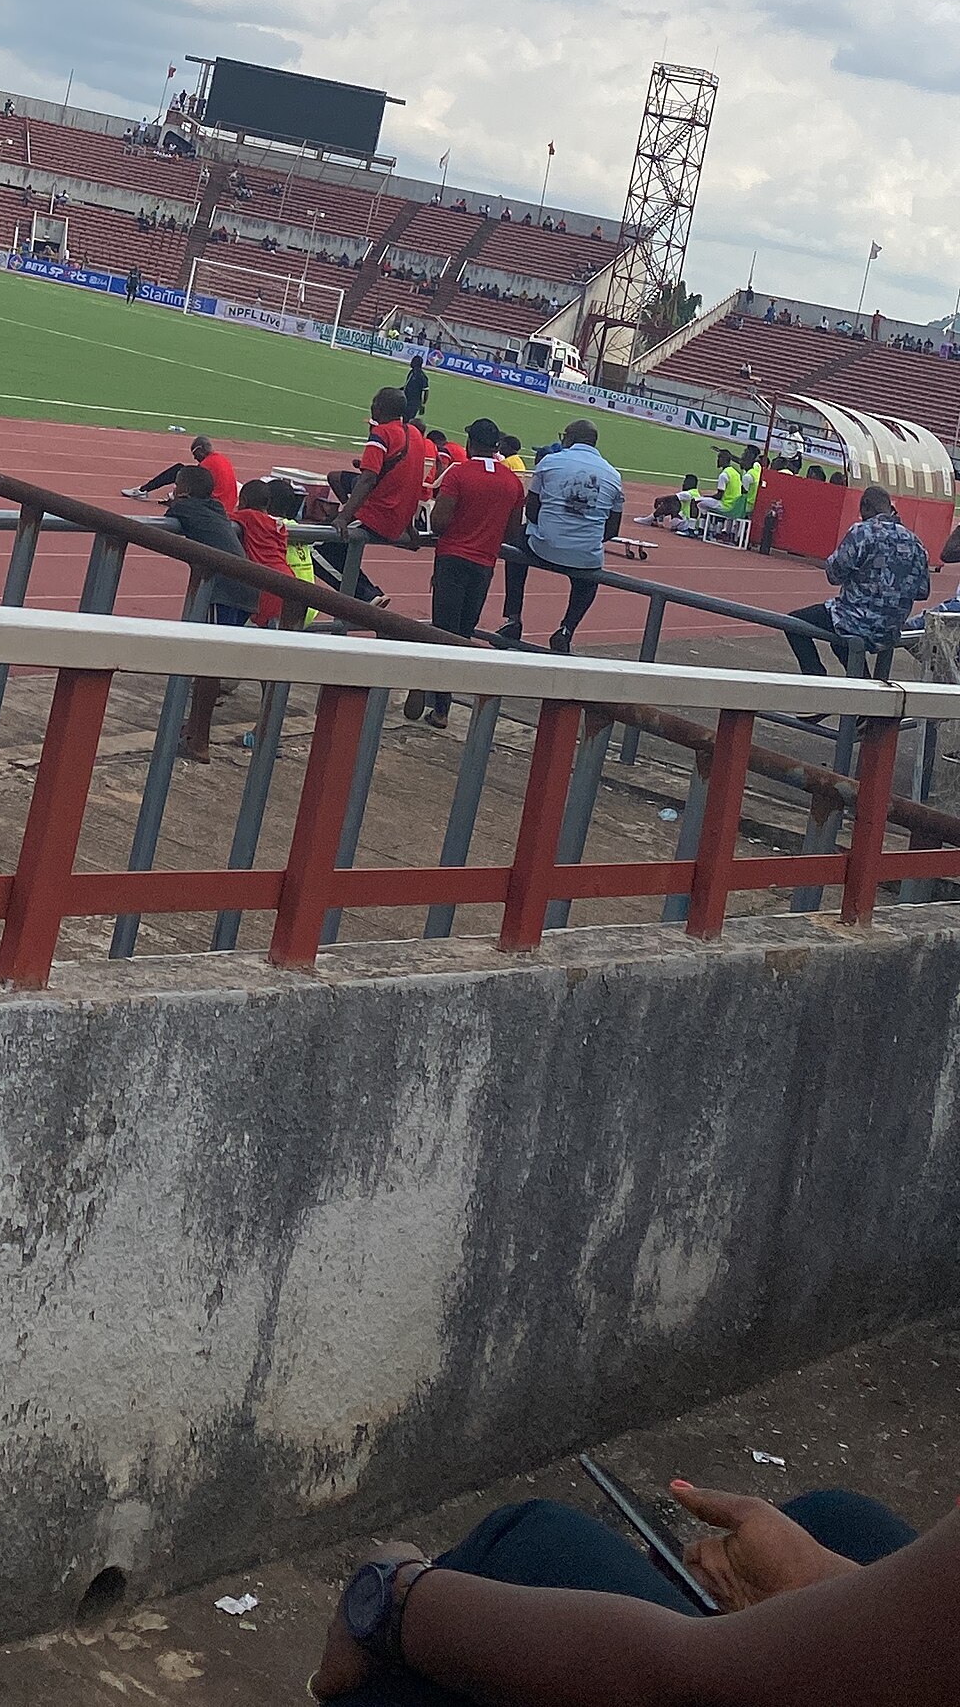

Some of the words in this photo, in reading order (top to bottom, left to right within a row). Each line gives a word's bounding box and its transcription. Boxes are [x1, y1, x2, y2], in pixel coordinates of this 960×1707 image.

[24, 261, 48, 274] BETA
[228, 305, 257, 320] NPFL
[260, 311, 281, 328] Live
[312, 323, 325, 335] THE
[325, 324, 351, 339] NIERIA
[385, 339, 404, 352] FUND
[446, 357, 473, 371] BETA
[552, 378, 568, 389] THE
[568, 382, 605, 397] NIGERIA
[605, 390, 652, 408] FOOTBALL
[652, 401, 678, 415] FUND
[685, 411, 766, 442] NPFL
